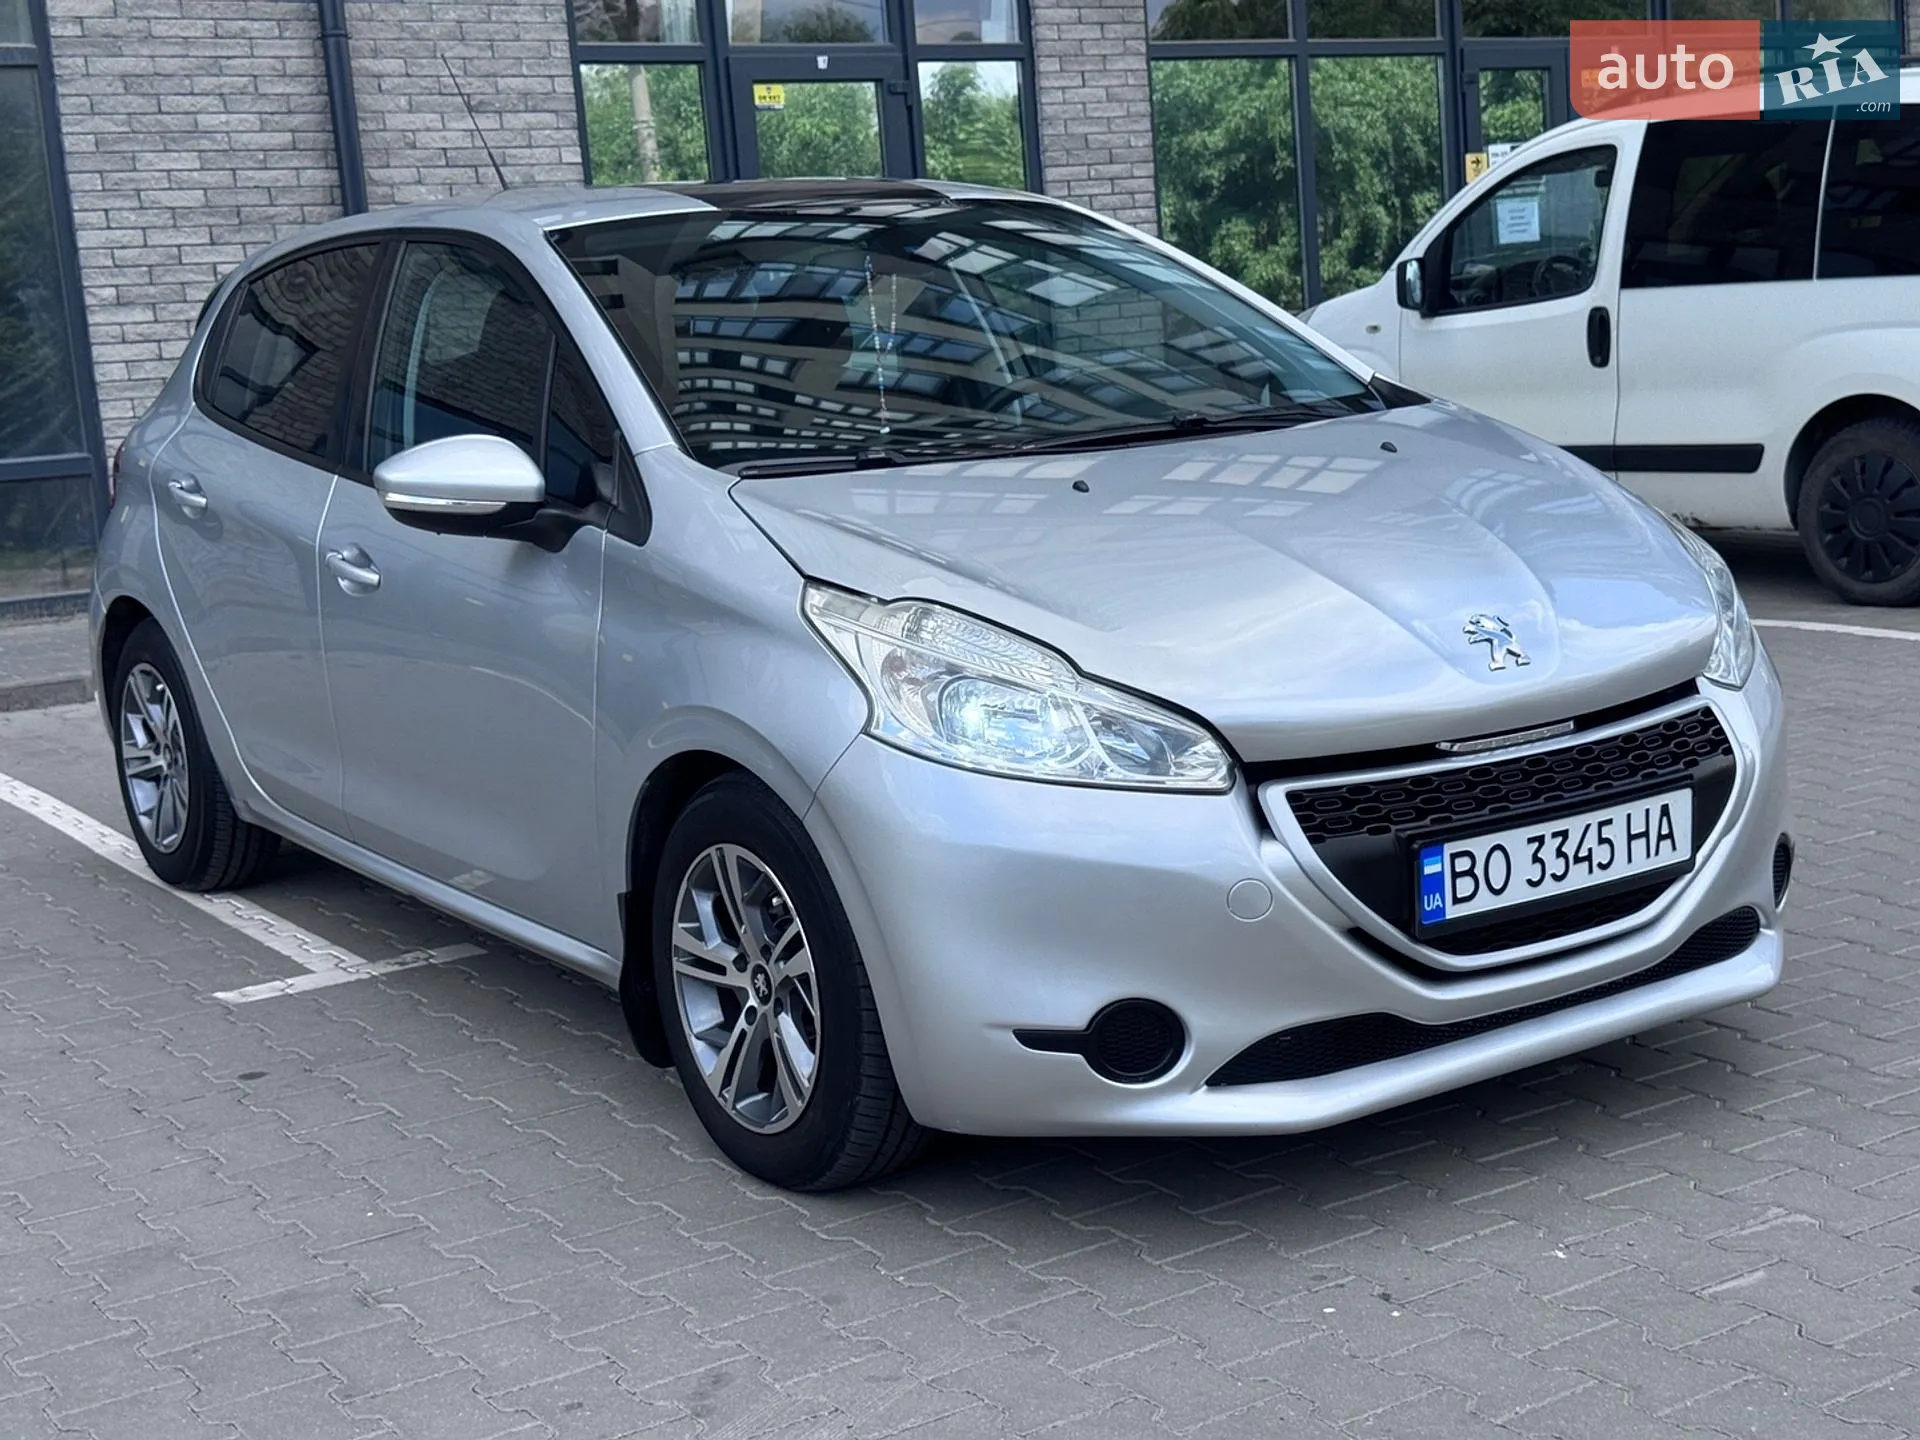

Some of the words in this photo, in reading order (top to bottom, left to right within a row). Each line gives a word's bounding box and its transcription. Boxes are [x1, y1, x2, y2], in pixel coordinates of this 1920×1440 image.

[1449, 843, 1511, 906] BO
[1525, 818, 1615, 888] 3345
[1626, 803, 1677, 864] HA
[1424, 892, 1443, 911] UA
